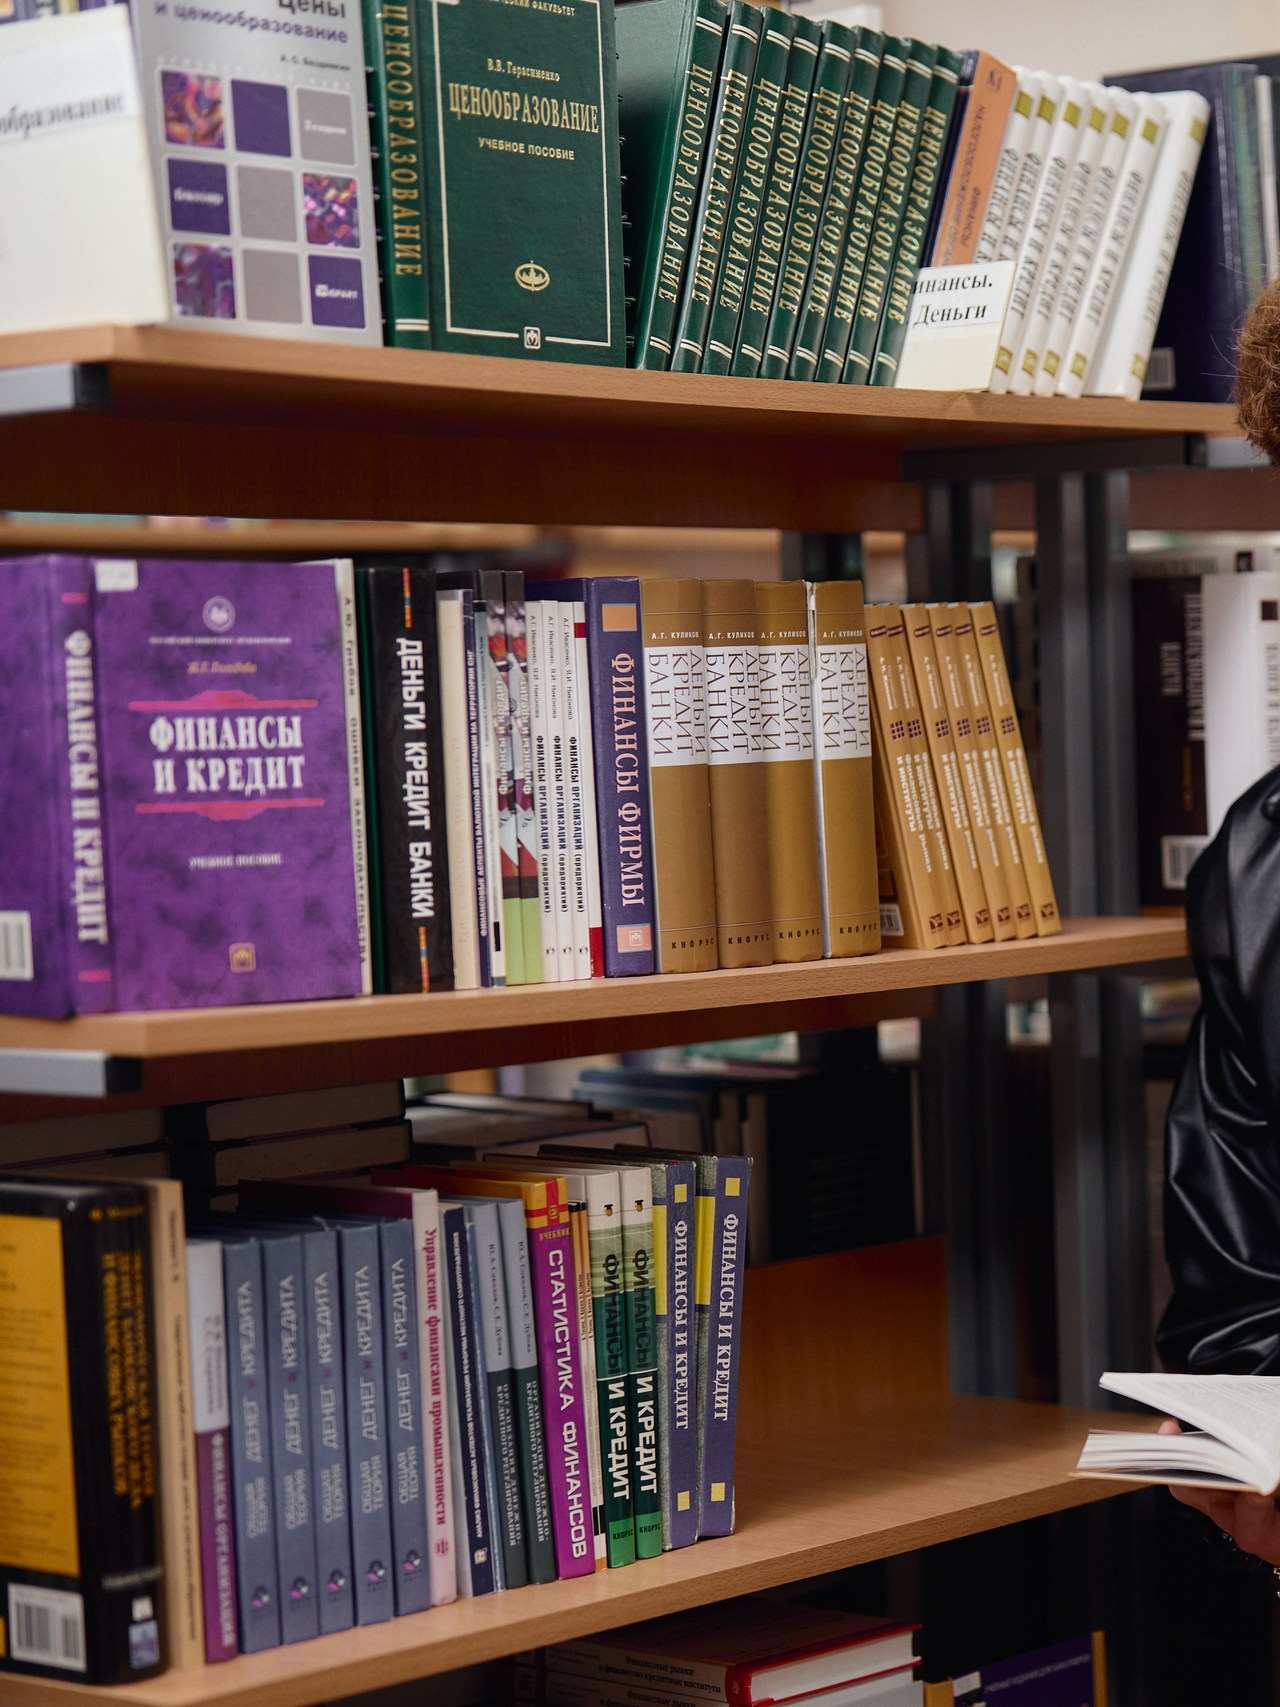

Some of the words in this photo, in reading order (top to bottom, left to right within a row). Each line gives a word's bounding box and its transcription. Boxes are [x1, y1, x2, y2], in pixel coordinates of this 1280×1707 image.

[173, 4, 348, 43] ценообразование
[382, 4, 423, 277] ЦЕНООБРАЗОВАНИЕ
[448, 82, 599, 134] ЦЕНООБРАЗОВАНИЕ
[478, 136, 525, 154] УЧЕБНОЕ
[528, 144, 575, 161] ПОСОБИЕ
[658, 64, 713, 303] ЦЕНООБРАЗОВАНИЕ
[691, 68, 748, 305] ЦЕНООБРАЗОВАНИЕ
[720, 78, 780, 313] ЦЕНООБРАЗОВАНИЕ
[750, 84, 808, 317] ЦЕНООБРАЗОВАНИЕ
[779, 86, 841, 315] ЦЕНООБРАЗОВАНИЕ
[808, 91, 870, 320] ЦЕНООБРАЗОВАНИЕ
[834, 99, 896, 323] ЦЕНООБРАЗОВАНИЕ
[858, 100, 920, 321] ЦЕНООБРАЗОВАНИЕ
[887, 105, 947, 323] ЦЕНООБРАЗОВАНИЕ
[913, 273, 993, 295] инансы.
[914, 305, 987, 326] Деньги
[64, 630, 99, 789] ФИНАНСЫ
[396, 638, 427, 730] ДЕНЬГИ
[611, 652, 640, 793] ФИНАНСЫ
[649, 654, 673, 755] БАНКИ
[672, 653, 694, 757] КРЕДИТ
[705, 653, 730, 754] БАНКИ
[728, 653, 749, 755] КРЕДИТ
[759, 652, 782, 751] БАНКИ
[780, 652, 800, 752] КРЕДИТ
[821, 652, 841, 749] БАНКИ
[840, 651, 858, 750] КРЕДИТ
[149, 715, 303, 751] ФИНАНСЫ
[153, 758, 176, 794] И
[185, 755, 305, 796] КРЕДИТ
[537, 735, 546, 782] ФИНАНСЫ
[553, 735, 562, 782] ФИНАНСЫ
[569, 736, 579, 783] ФИНАНСЫ
[72, 793, 100, 821] И
[402, 741, 431, 830] КРЕДИТ
[539, 785, 550, 849] ОРГАНИЗАЦИЙ
[556, 785, 567, 849] ОРГАНИЗАЦИЙ
[571, 785, 583, 850] ОРГАНИЗАЦИЙ
[72, 826, 109, 944] КРЕДИТ
[408, 841, 434, 918] БАНКИ
[617, 801, 645, 907] ФИРМЫ
[355, 1266, 372, 1356] КРЕДИТА
[391, 1258, 409, 1348] КРЕДИТА
[422, 1228, 438, 1311] Управление
[633, 1250, 649, 1368] ФИНАНСЫ
[674, 1220, 688, 1326] ФИНАНСЫ
[718, 1213, 739, 1319] ФИНАНСЫ
[314, 1272, 333, 1364] КРЕДИТА
[425, 1315, 442, 1396] финансами
[603, 1254, 622, 1375] ФИНАНСЫ
[675, 1332, 688, 1346] И
[718, 1324, 733, 1339] И
[320, 1384, 338, 1448] ДЕНЕГ
[360, 1376, 378, 1441] ДЕНЕГ
[397, 1368, 413, 1432] ДЕНЕГ
[549, 1249, 574, 1411] СТАТИСТИКА
[562, 1421, 587, 1558] ФИНАНСОВ
[608, 1381, 625, 1400] И
[636, 1375, 653, 1395] И
[674, 1353, 689, 1430] КРЕДИТ
[714, 1344, 732, 1421] КРЕДИТ
[429, 1401, 446, 1525] промышленности
[607, 1405, 630, 1500] КРЕДИТ
[635, 1400, 657, 1494] КРЕДИТ
